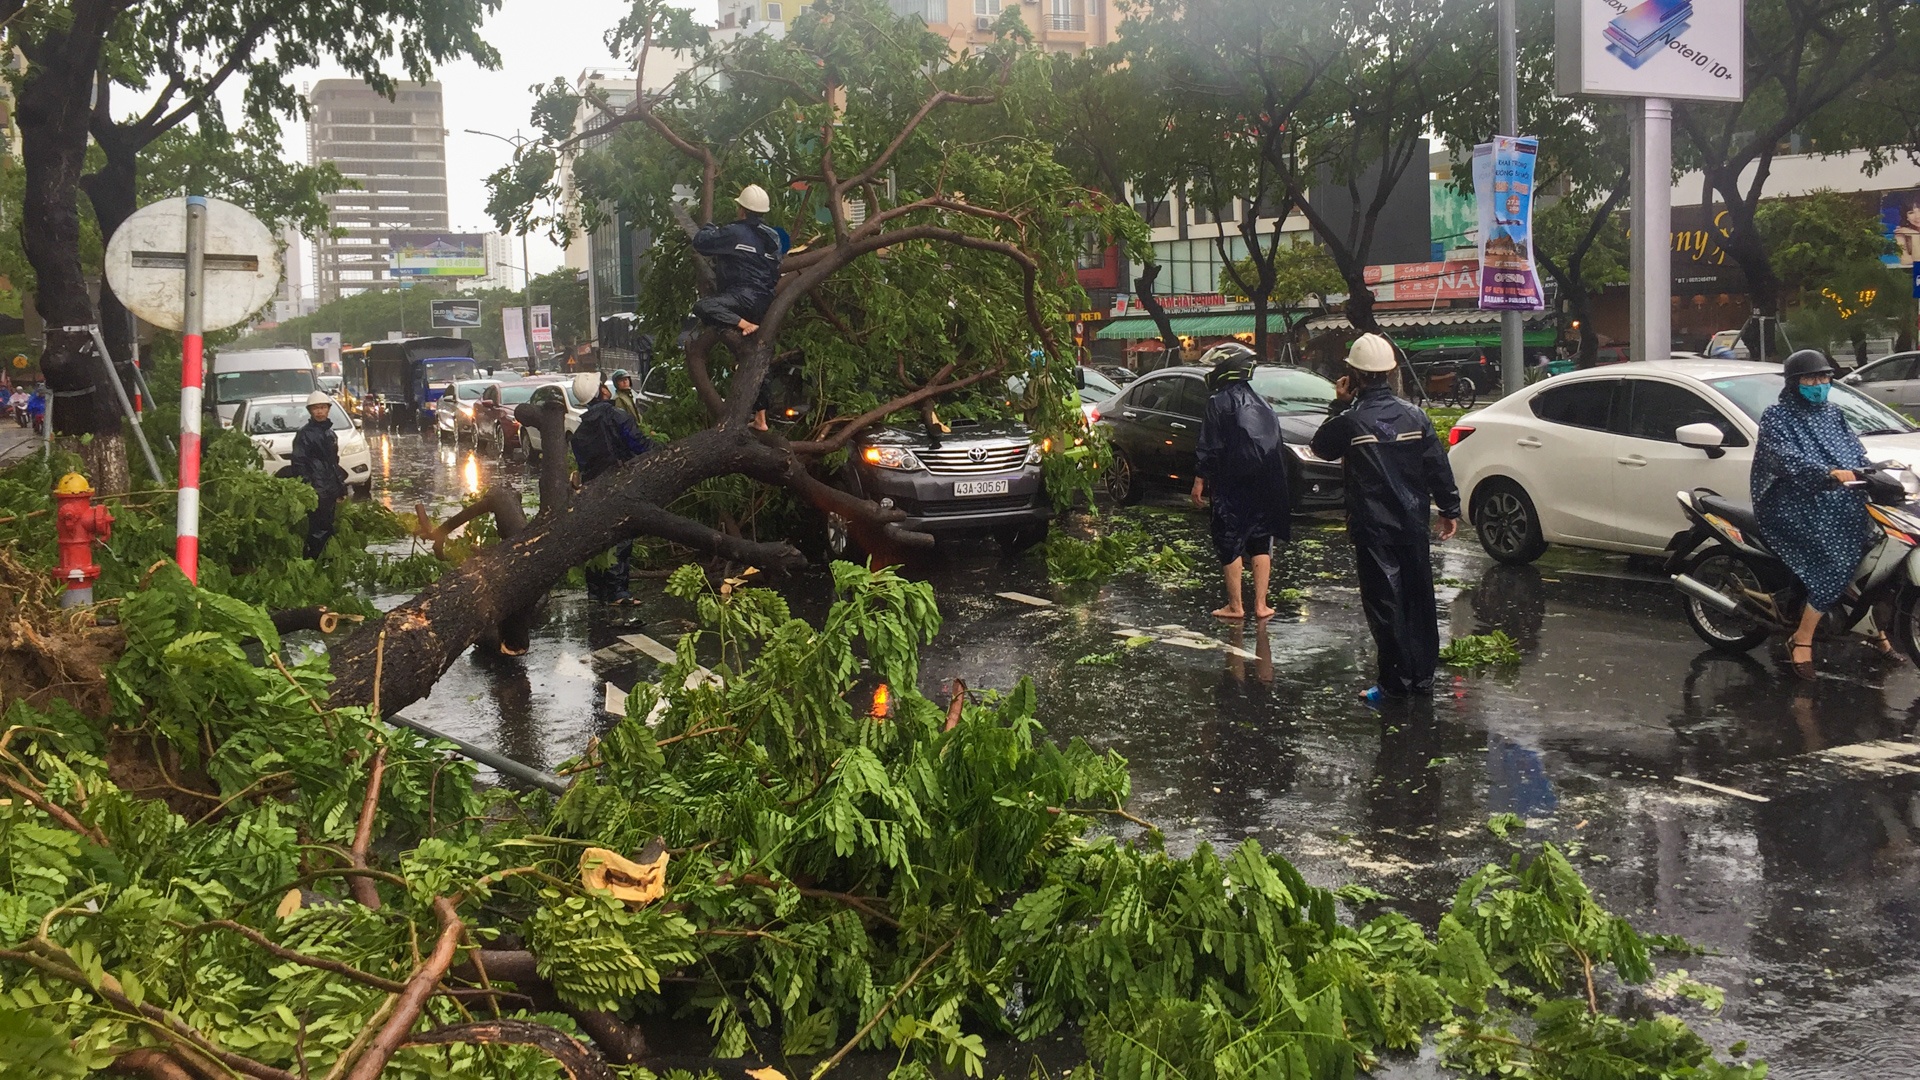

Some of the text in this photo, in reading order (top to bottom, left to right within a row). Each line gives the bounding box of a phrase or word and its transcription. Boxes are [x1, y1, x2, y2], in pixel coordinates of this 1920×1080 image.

[1659, 33, 1733, 81] Note10 10+
[1438, 265, 1480, 290] NÂ
[956, 480, 1007, 495] 43A-305.67
